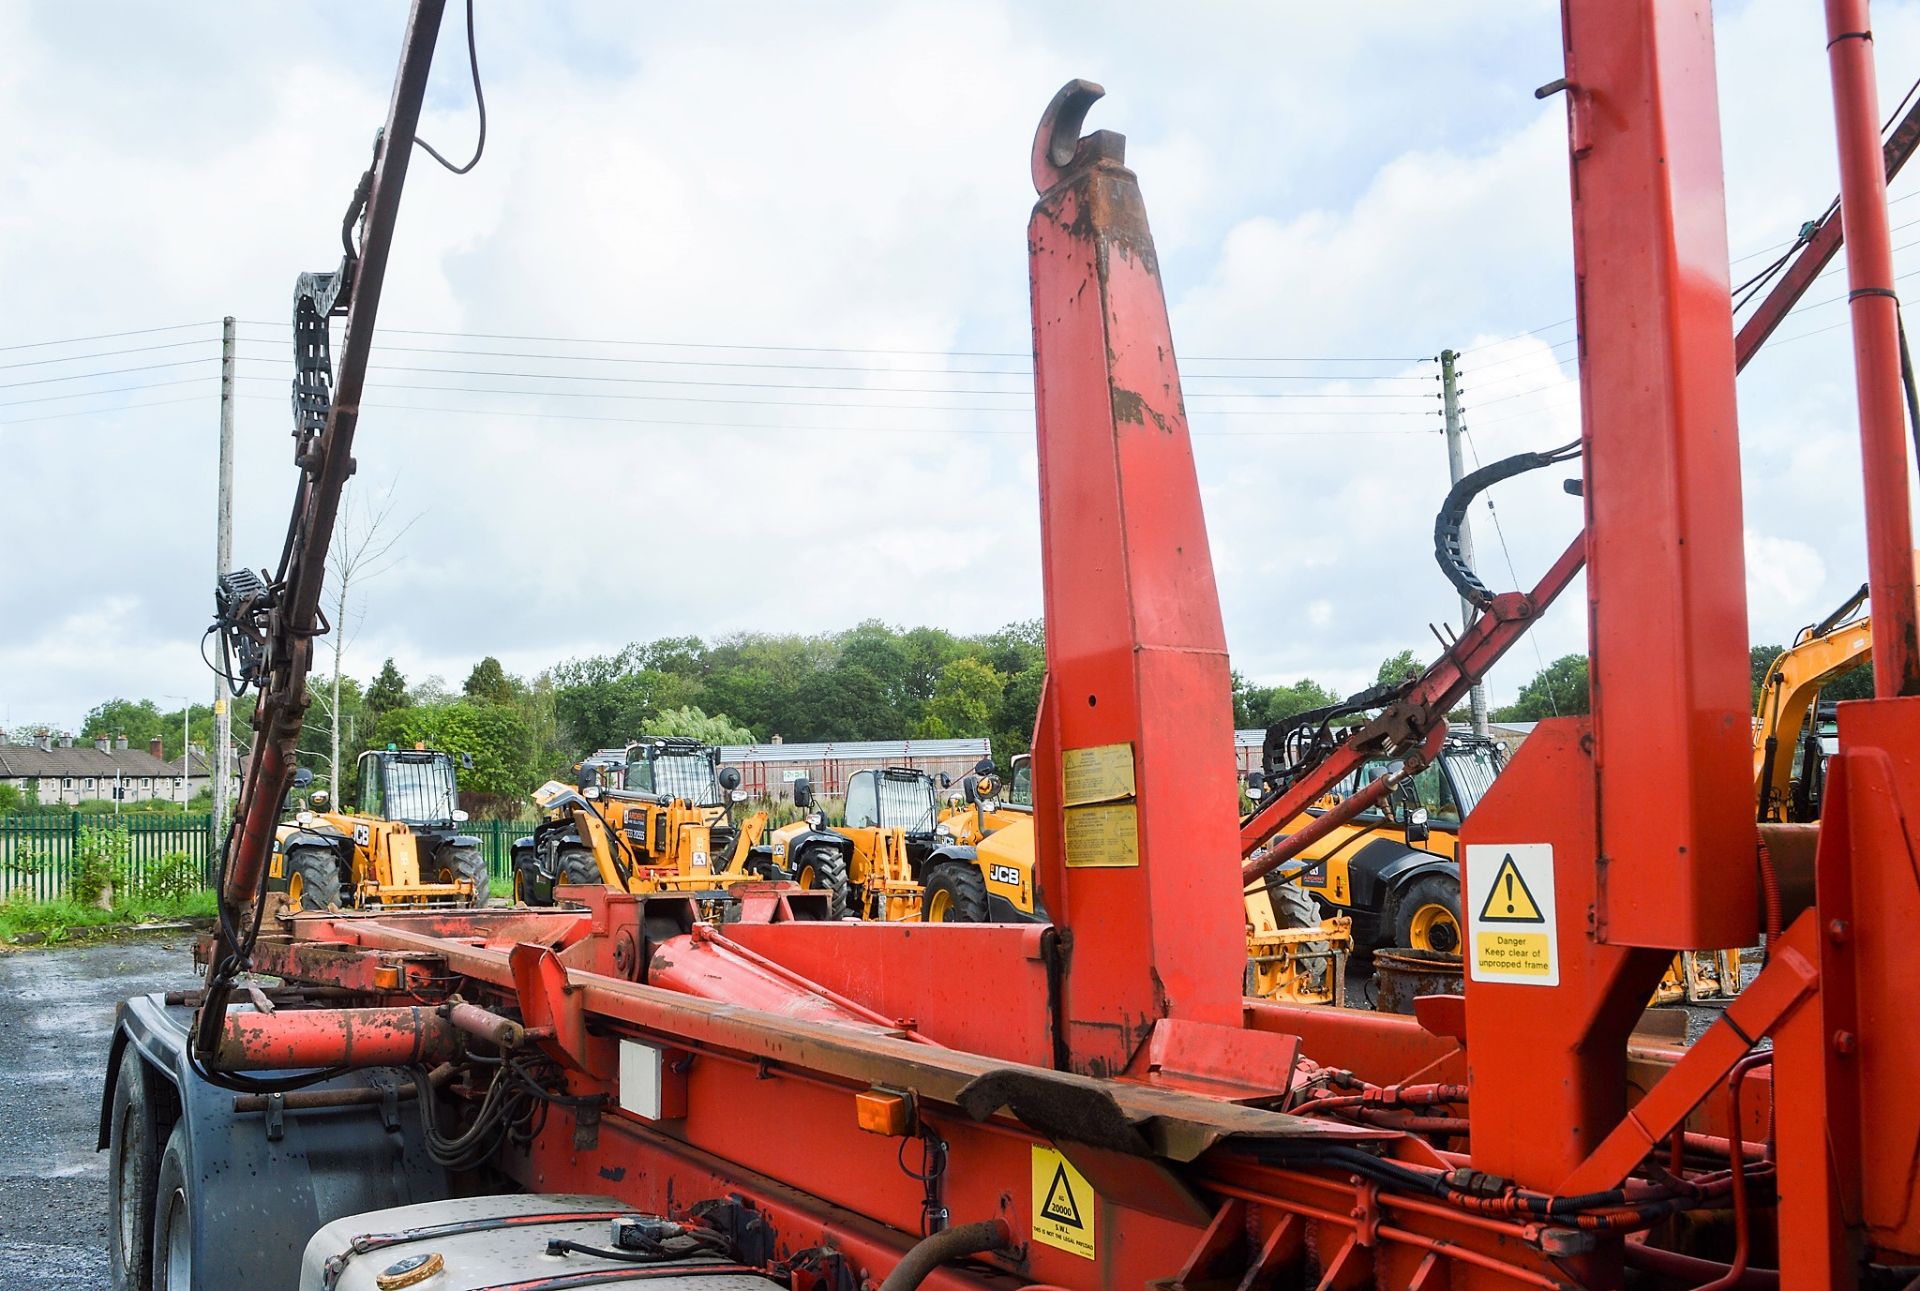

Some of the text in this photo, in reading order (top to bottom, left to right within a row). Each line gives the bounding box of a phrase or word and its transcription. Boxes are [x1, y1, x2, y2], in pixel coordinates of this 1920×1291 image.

[990, 865, 1019, 885] JCB
[1497, 936, 1526, 946] Danger
[1485, 947, 1541, 958] Keep clear of
[1479, 959, 1549, 969] unpropped frame
[1052, 1202, 1072, 1216] 20000
[1062, 1235, 1075, 1245] LEGAL
[1076, 1239, 1093, 1251] PAYLOAD
